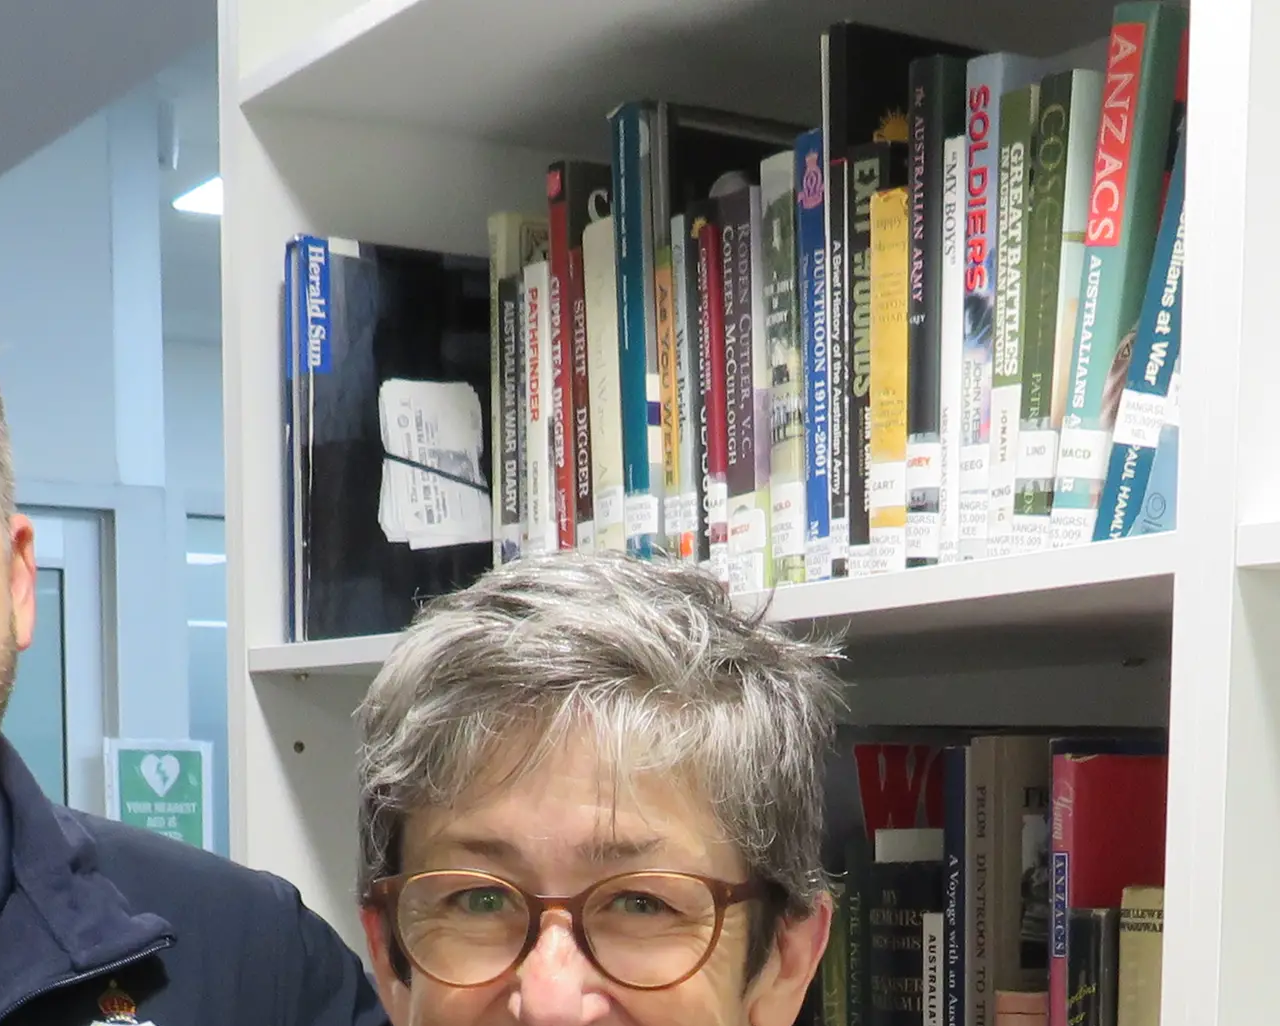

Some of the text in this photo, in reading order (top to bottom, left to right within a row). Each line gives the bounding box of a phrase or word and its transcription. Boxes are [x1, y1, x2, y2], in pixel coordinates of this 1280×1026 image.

[966, 84, 990, 293] SOLDIERS
[1088, 32, 1138, 241] ANZACS
[722, 225, 734, 316] COLLEEN
[910, 115, 925, 302] AUSTRALIAN ARMY
[1005, 142, 1025, 376] GREAT BATTLES
[308, 244, 326, 367] Herald Sun
[527, 287, 540, 423] PATHFINDER
[661, 332, 671, 389] YOU
[738, 223, 752, 460] RODEN V.C.
[813, 249, 828, 477] DUNTROON 1911-2001
[830, 239, 842, 496] A Brief History of the Australian Army
[1072, 254, 1102, 408] AUSTRALIANS
[1144, 310, 1171, 387] at War
[503, 301, 518, 513] AUSTRALIAN WAR DIARY
[573, 300, 589, 500] SPIRIT DIGGER
[976, 785, 987, 839] FROM
[946, 870, 959, 926] Voyage
[948, 930, 959, 965] with
[976, 853, 987, 959] DUNTROON
[948, 969, 957, 984] an
[976, 965, 986, 994] TO
